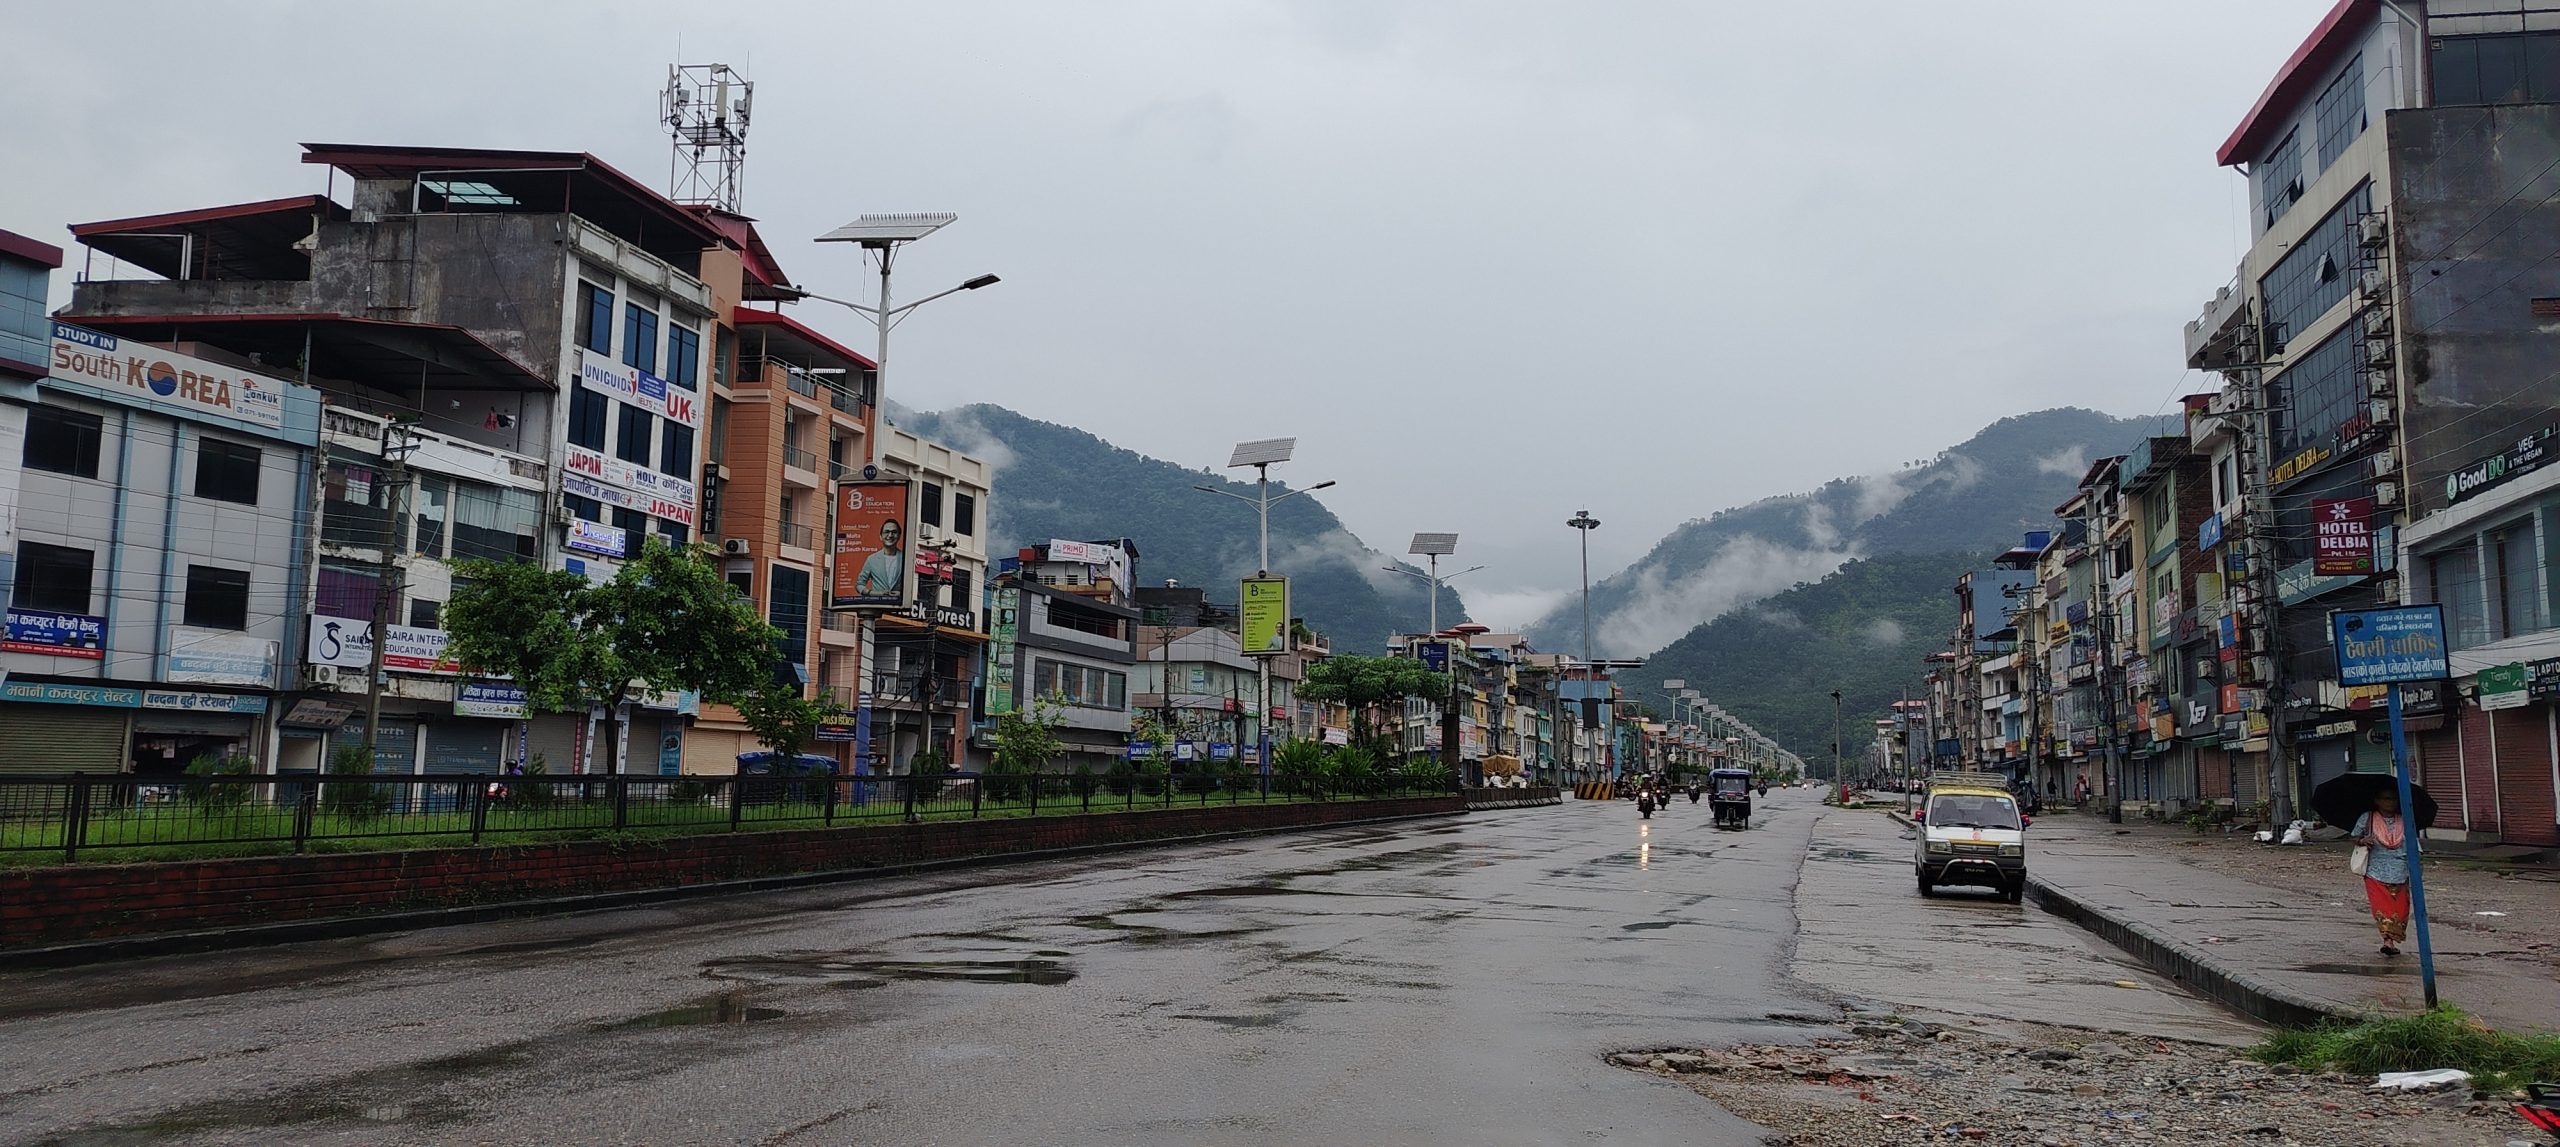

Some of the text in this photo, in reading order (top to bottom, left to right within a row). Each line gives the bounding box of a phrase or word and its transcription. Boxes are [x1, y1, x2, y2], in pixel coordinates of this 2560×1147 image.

[57, 325, 114, 350] STUDY IN
[54, 343, 121, 382] South
[667, 391, 692, 423] UK
[2518, 435, 2534, 453] VEG
[568, 451, 601, 476] JAPAN
[2513, 456, 2523, 468] THE
[2523, 446, 2543, 463] VEGAN
[636, 469, 657, 485] HOLY
[2275, 460, 2295, 485] HOTEL
[2459, 462, 2487, 492] Good
[648, 500, 692, 524] JAPAN
[704, 475, 718, 533] HOTEL
[2319, 521, 2367, 534] HOTEL
[2320, 536, 2369, 548] DELBIA
[385, 630, 415, 643] SAIRA
[384, 644, 427, 656] EDUCATION
[428, 648, 433, 657] &
[7, 684, 44, 698] भवानी
[49, 687, 98, 704] कम्प्यूटर
[2404, 690, 2419, 706] Apple
[2420, 688, 2434, 702] Zone
